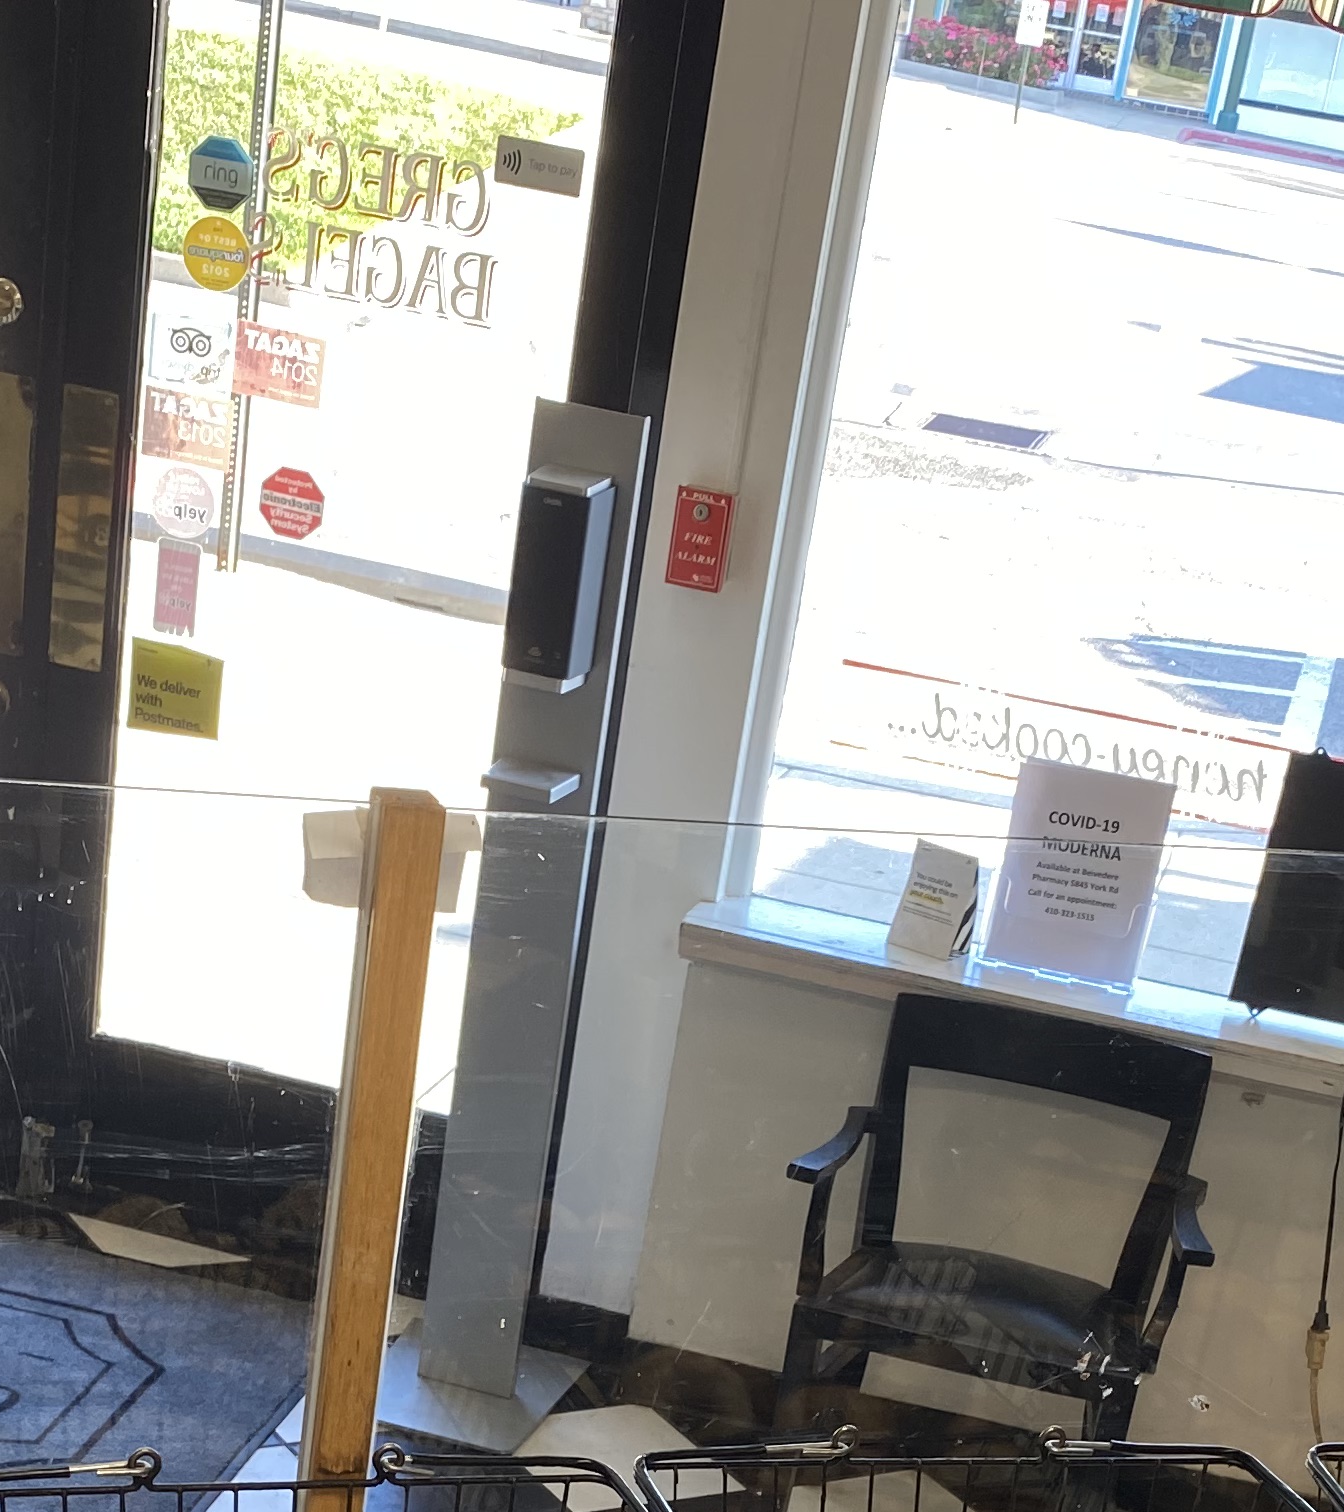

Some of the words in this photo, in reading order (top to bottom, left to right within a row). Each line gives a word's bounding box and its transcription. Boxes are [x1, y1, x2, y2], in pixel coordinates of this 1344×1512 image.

[204, 160, 238, 189] ring
[528, 159, 546, 173] Tap
[547, 163, 558, 173] to
[559, 166, 578, 178] pay
[684, 532, 713, 545] FIRE
[676, 551, 716, 566] ALARM
[137, 673, 157, 689] We
[160, 680, 201, 698] deliver
[135, 692, 162, 708] with
[135, 706, 204, 733] Postmates.
[1049, 811, 1120, 833] COVID-19
[1042, 837, 1121, 861] MODERNA
[1037, 861, 1071, 873] Available
[1028, 888, 1042, 897] Call
[1043, 890, 1054, 898] for
[1032, 873, 1068, 887] Pharmacy
[1090, 883, 1107, 892] York
[1108, 886, 1119, 894] Rd
